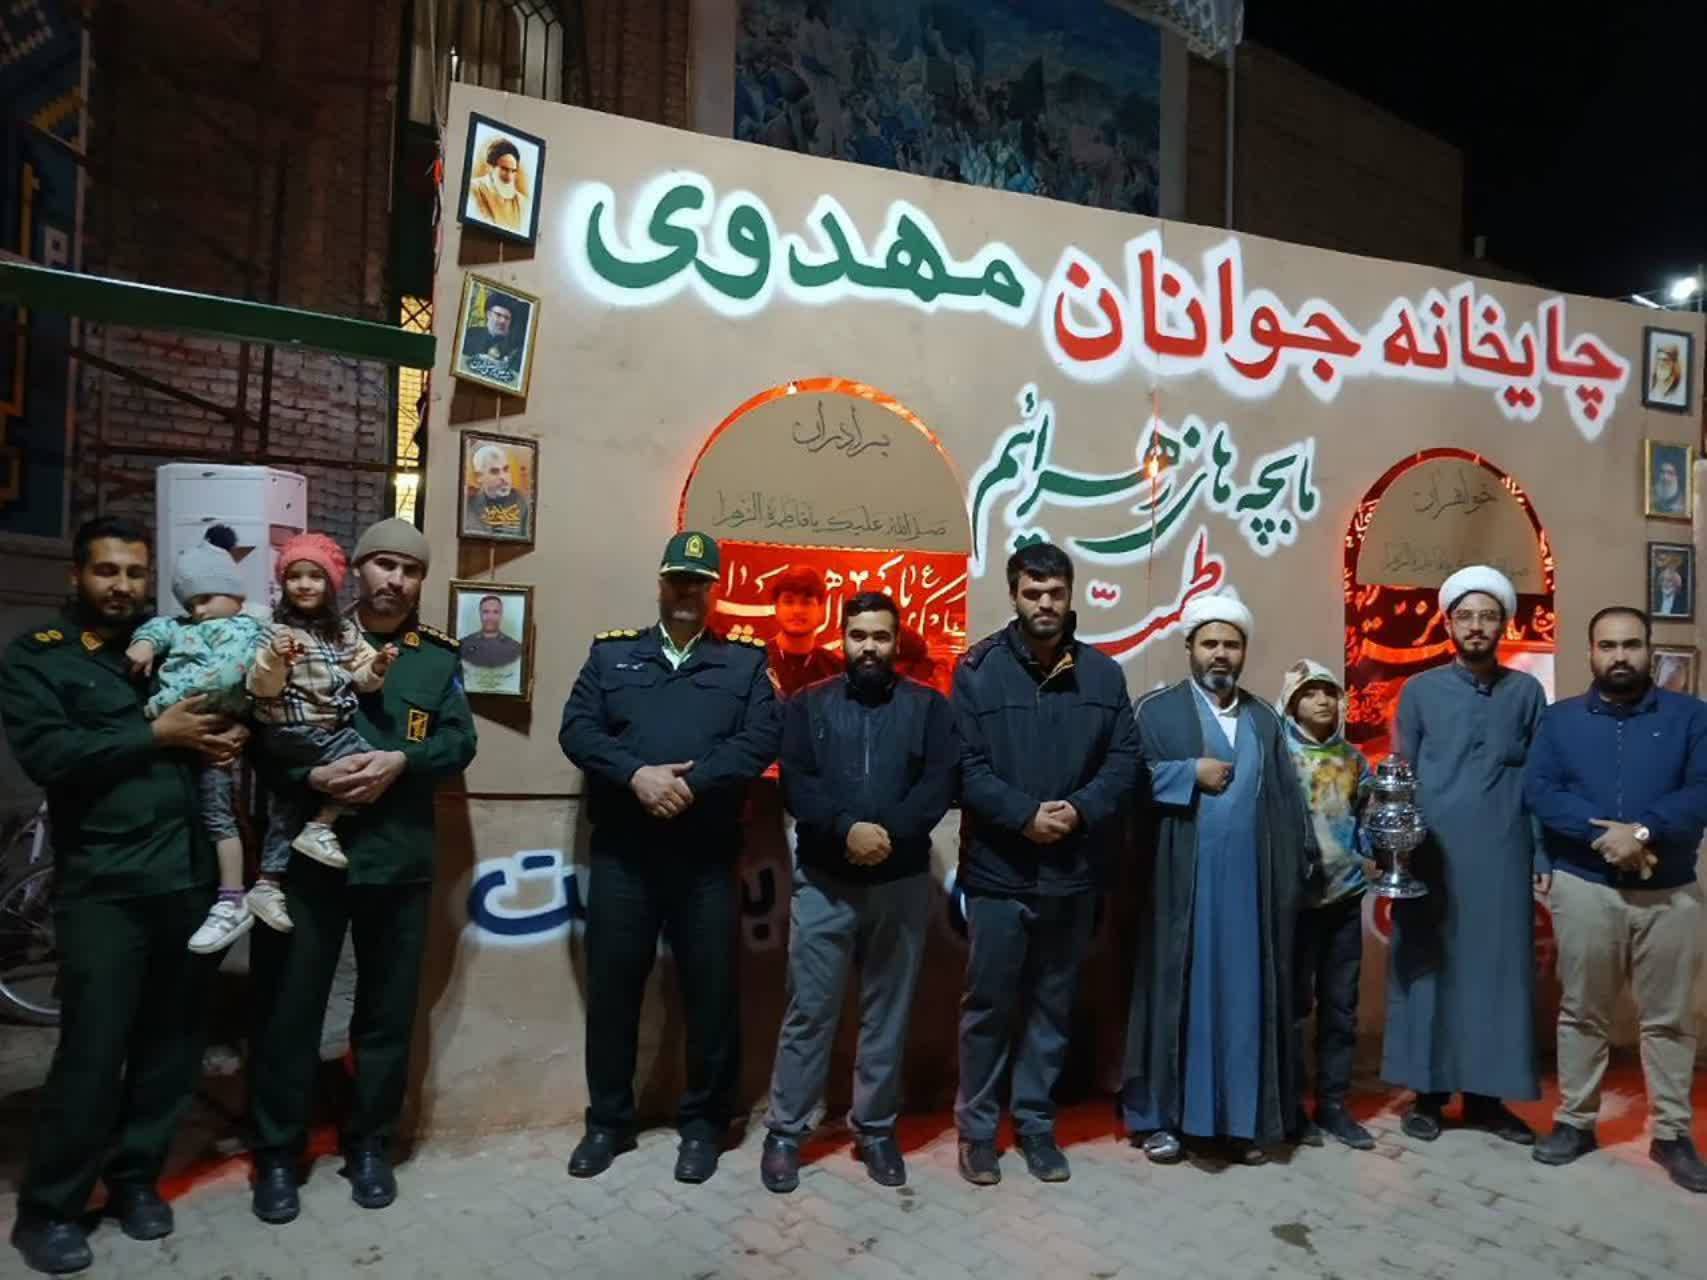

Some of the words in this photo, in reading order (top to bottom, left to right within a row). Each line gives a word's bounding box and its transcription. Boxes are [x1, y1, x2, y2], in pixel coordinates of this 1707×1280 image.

[586, 184, 1026, 307] مهدوی
[1054, 248, 1362, 382] جوانان
[1383, 295, 1625, 421] چایخانه
[791, 400, 890, 457] برادران
[1413, 467, 1498, 520] خواهران
